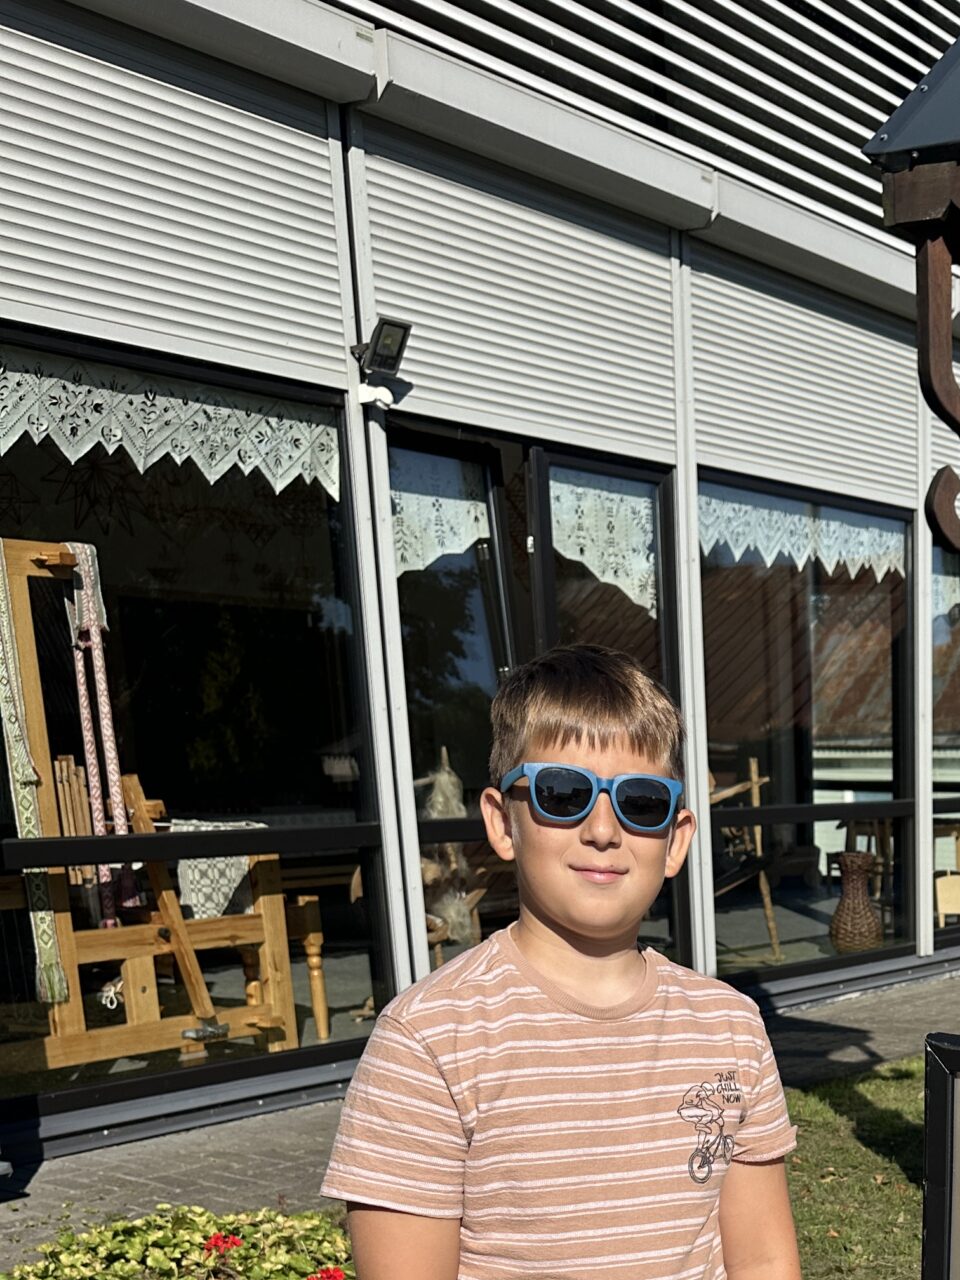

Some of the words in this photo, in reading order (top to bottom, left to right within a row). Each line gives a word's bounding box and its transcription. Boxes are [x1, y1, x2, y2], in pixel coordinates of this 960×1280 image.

[714, 1071, 736, 1083] JUST
[717, 1082, 740, 1093] CHILL
[722, 1094, 741, 1105] NOW
